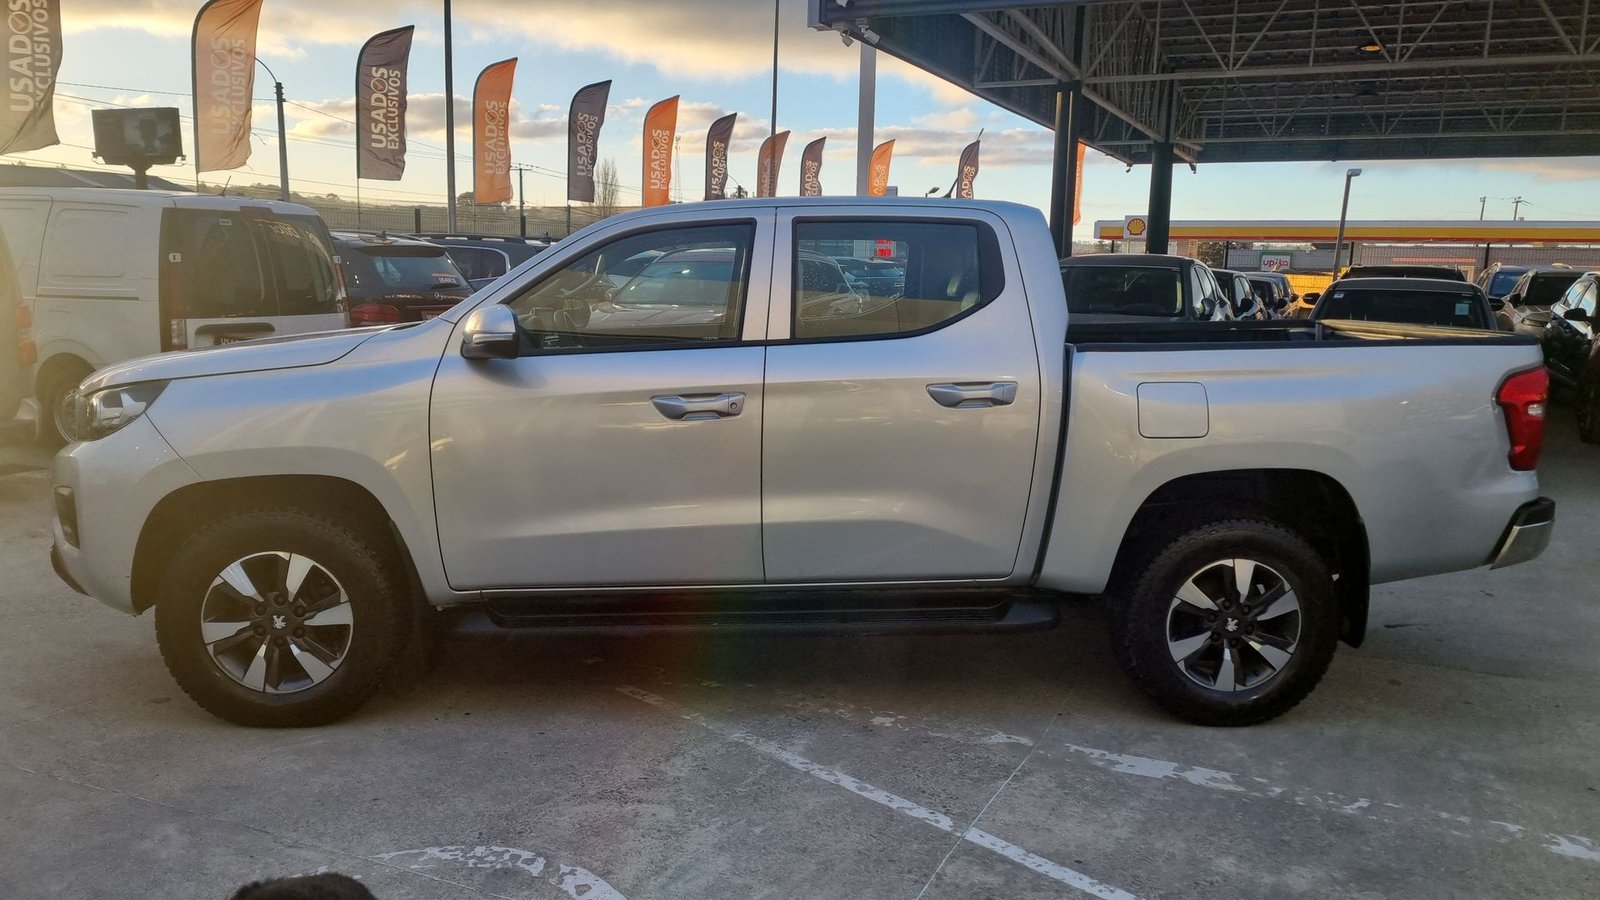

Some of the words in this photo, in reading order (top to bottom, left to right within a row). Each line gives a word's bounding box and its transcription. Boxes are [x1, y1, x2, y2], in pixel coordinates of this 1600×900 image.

[8, 0, 34, 112] USADOS
[211, 37, 232, 135] USADOS
[371, 67, 388, 148] USADOS
[387, 69, 401, 150] EXCLUSIVOS
[484, 100, 500, 174] USADOS
[576, 112, 590, 176] USADOS
[650, 129, 662, 189] USADOS
[711, 140, 722, 195] USADOS
[804, 160, 812, 197] SADOS
[873, 164, 882, 195] ADOS
[961, 165, 972, 199] ADOS
